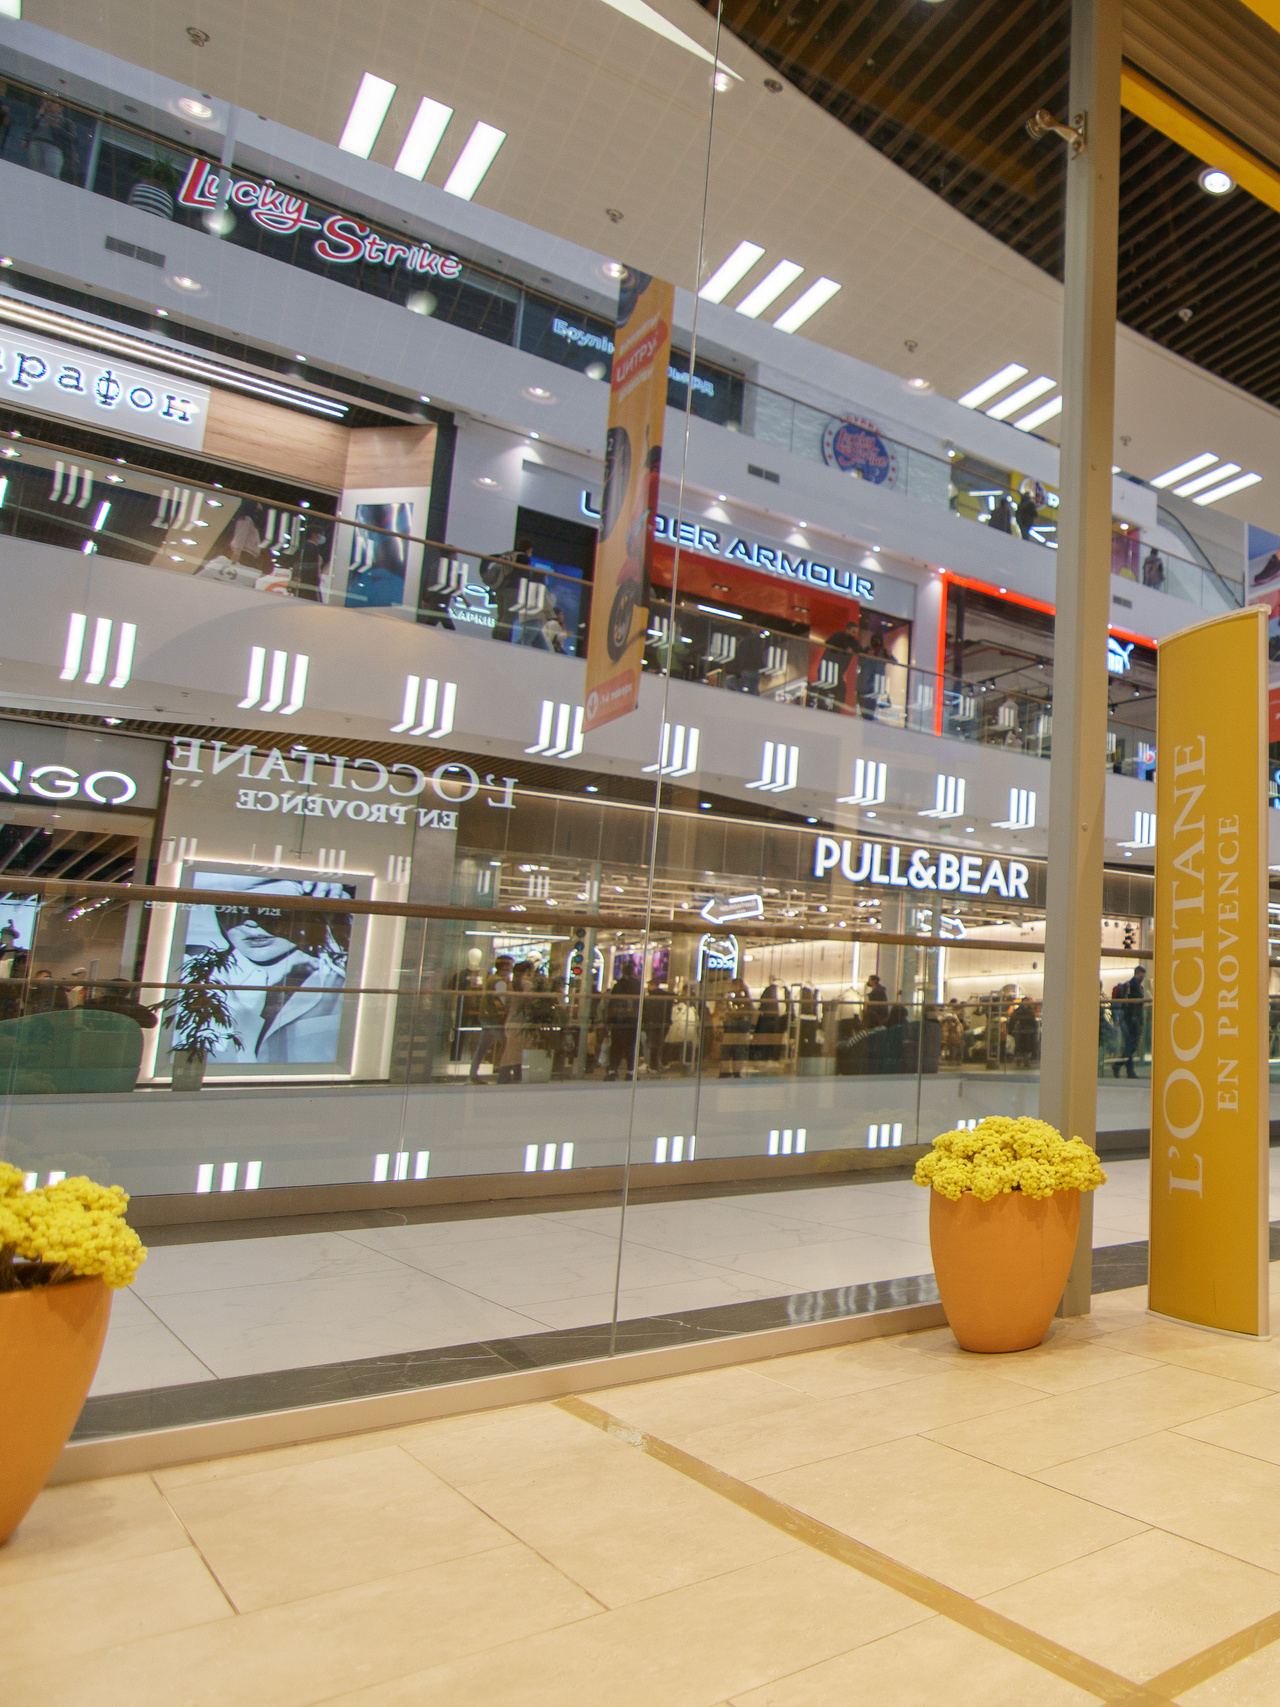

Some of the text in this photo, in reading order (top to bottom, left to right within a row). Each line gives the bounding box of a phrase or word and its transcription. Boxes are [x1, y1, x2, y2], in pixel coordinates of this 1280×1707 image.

[179, 157, 462, 278] Lucky Strike
[0, 348, 190, 422] рафон
[725, 537, 875, 600] ARMOUR
[814, 836, 1030, 899] PULL&BEAR
[1163, 734, 1206, 1199] L'OCCITANE
[1217, 813, 1240, 1113] EN PROVENCE
